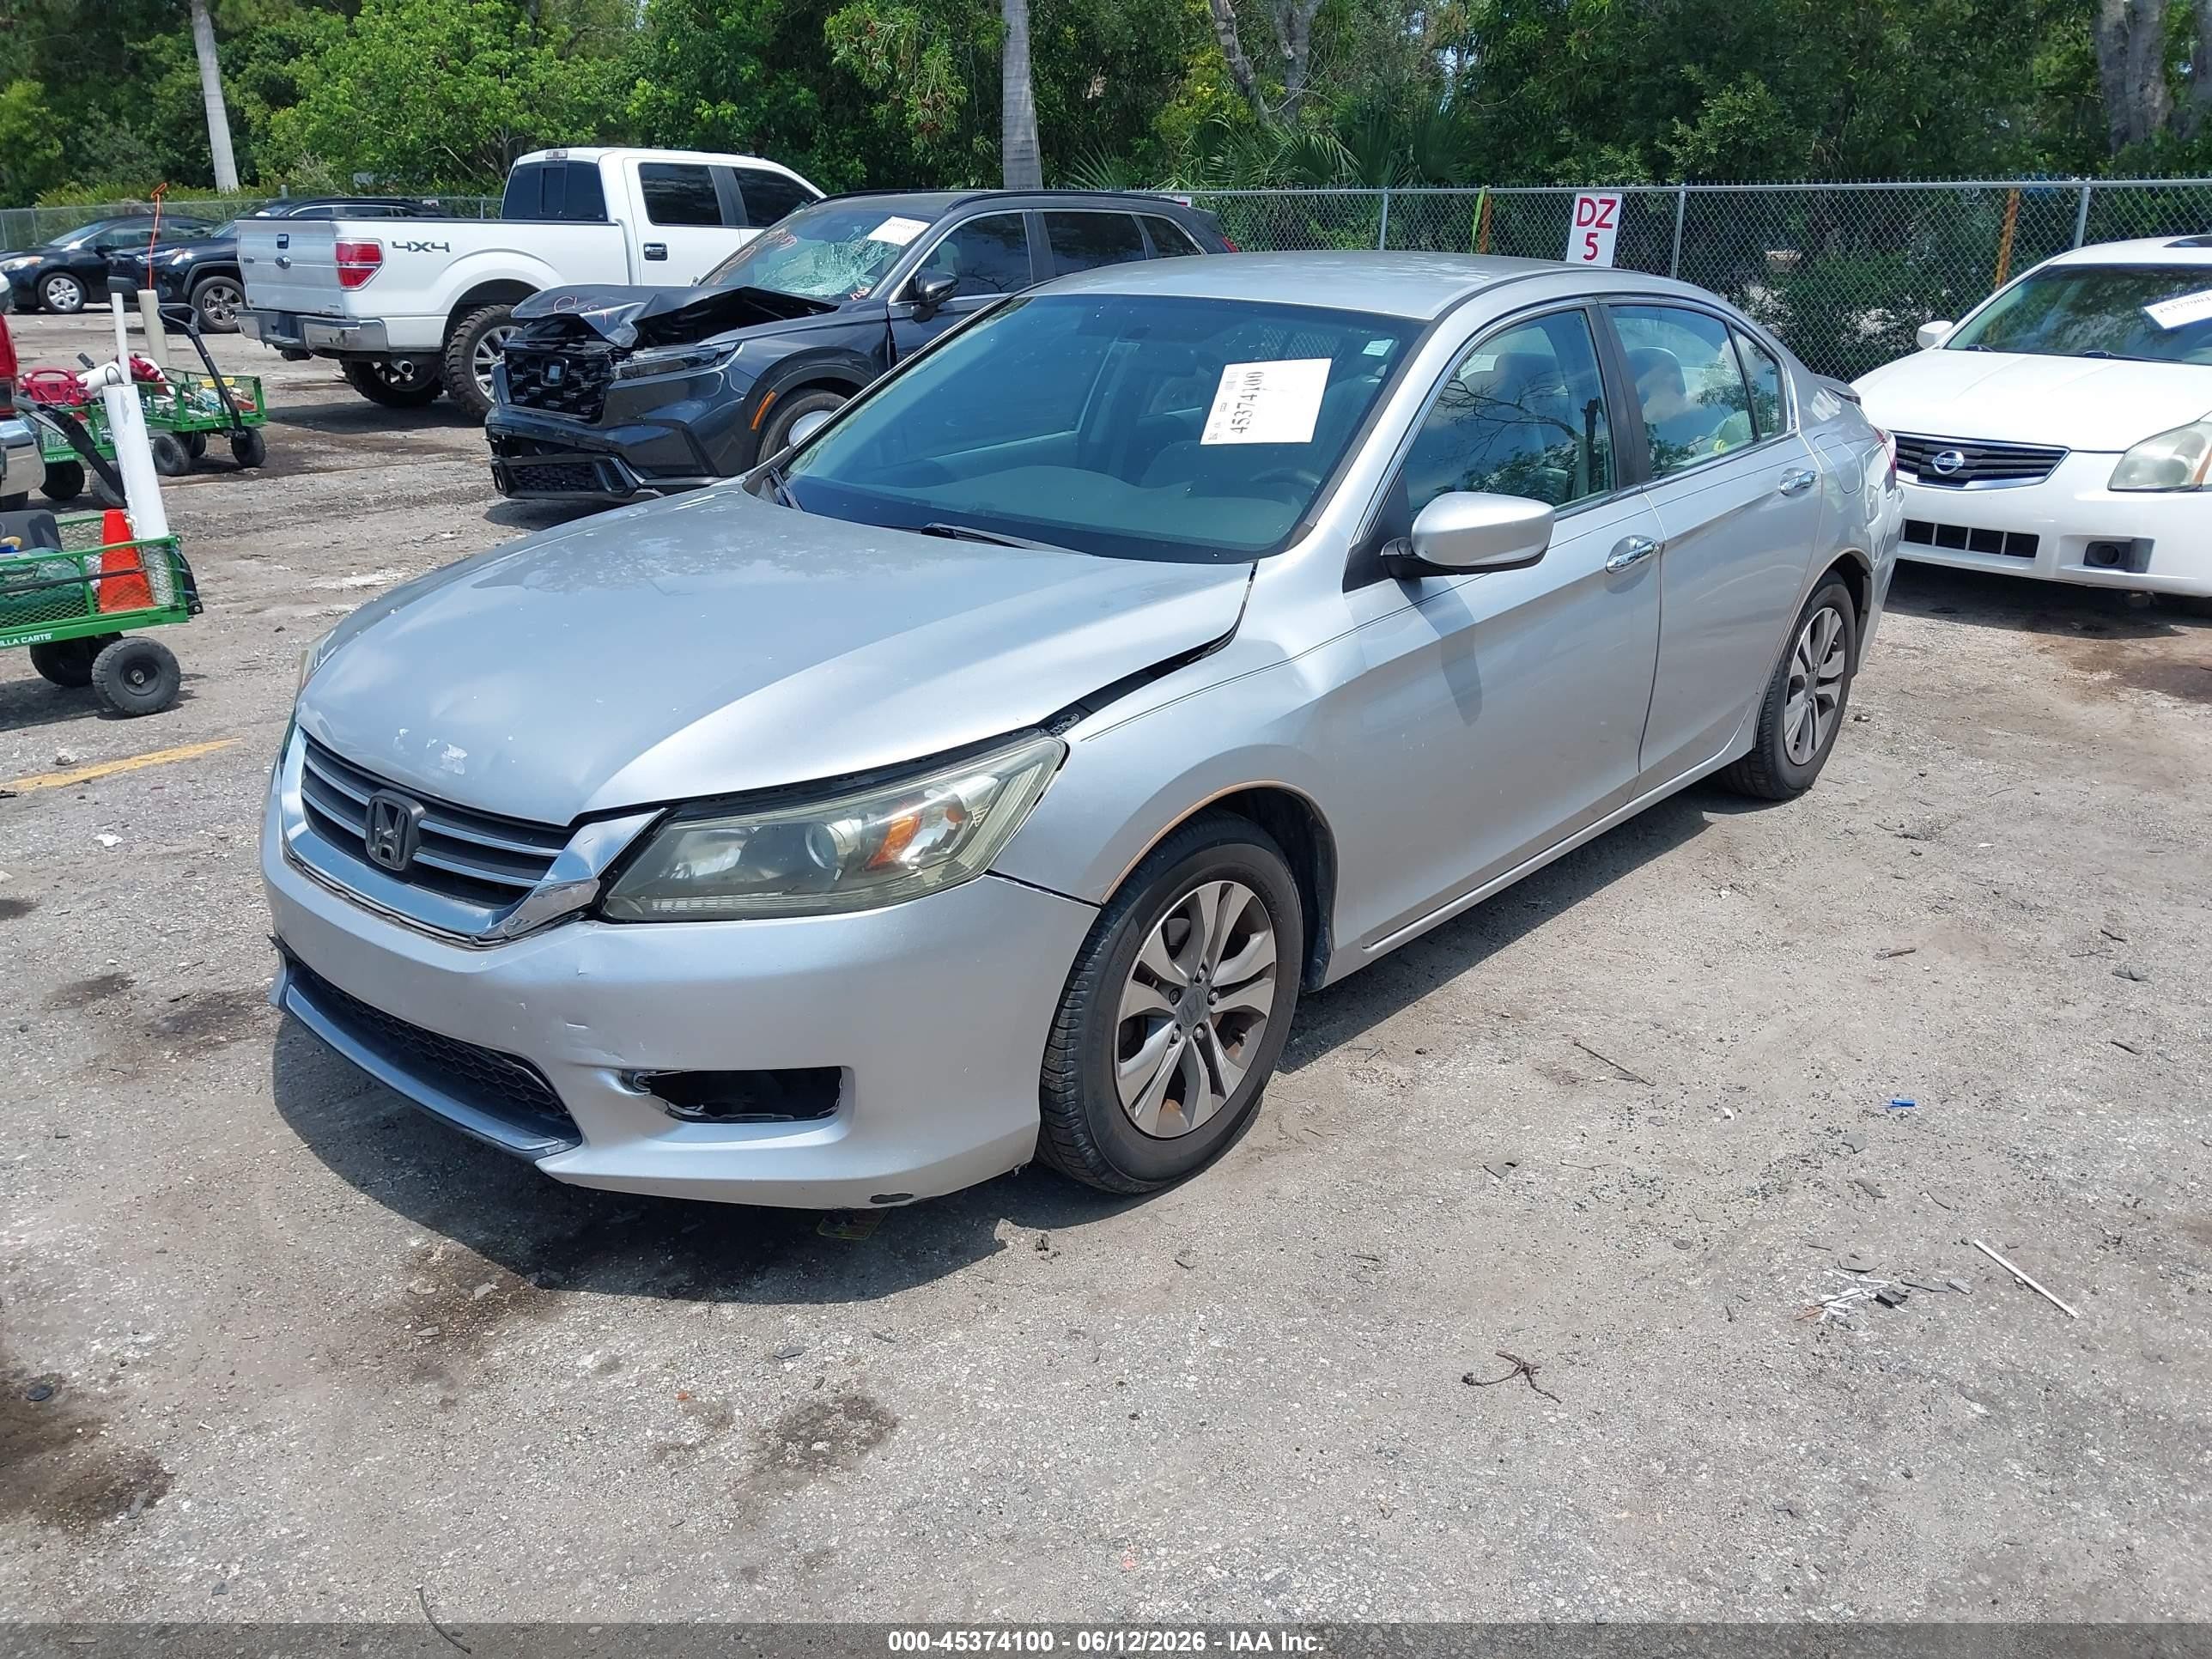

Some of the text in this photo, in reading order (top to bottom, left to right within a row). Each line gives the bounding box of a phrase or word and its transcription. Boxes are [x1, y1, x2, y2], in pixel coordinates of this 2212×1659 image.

[1576, 197, 1618, 229] DZ
[1583, 232, 1599, 261] 5
[1229, 371, 1265, 434] 45374100
[21, 634, 52, 644] CARTS
